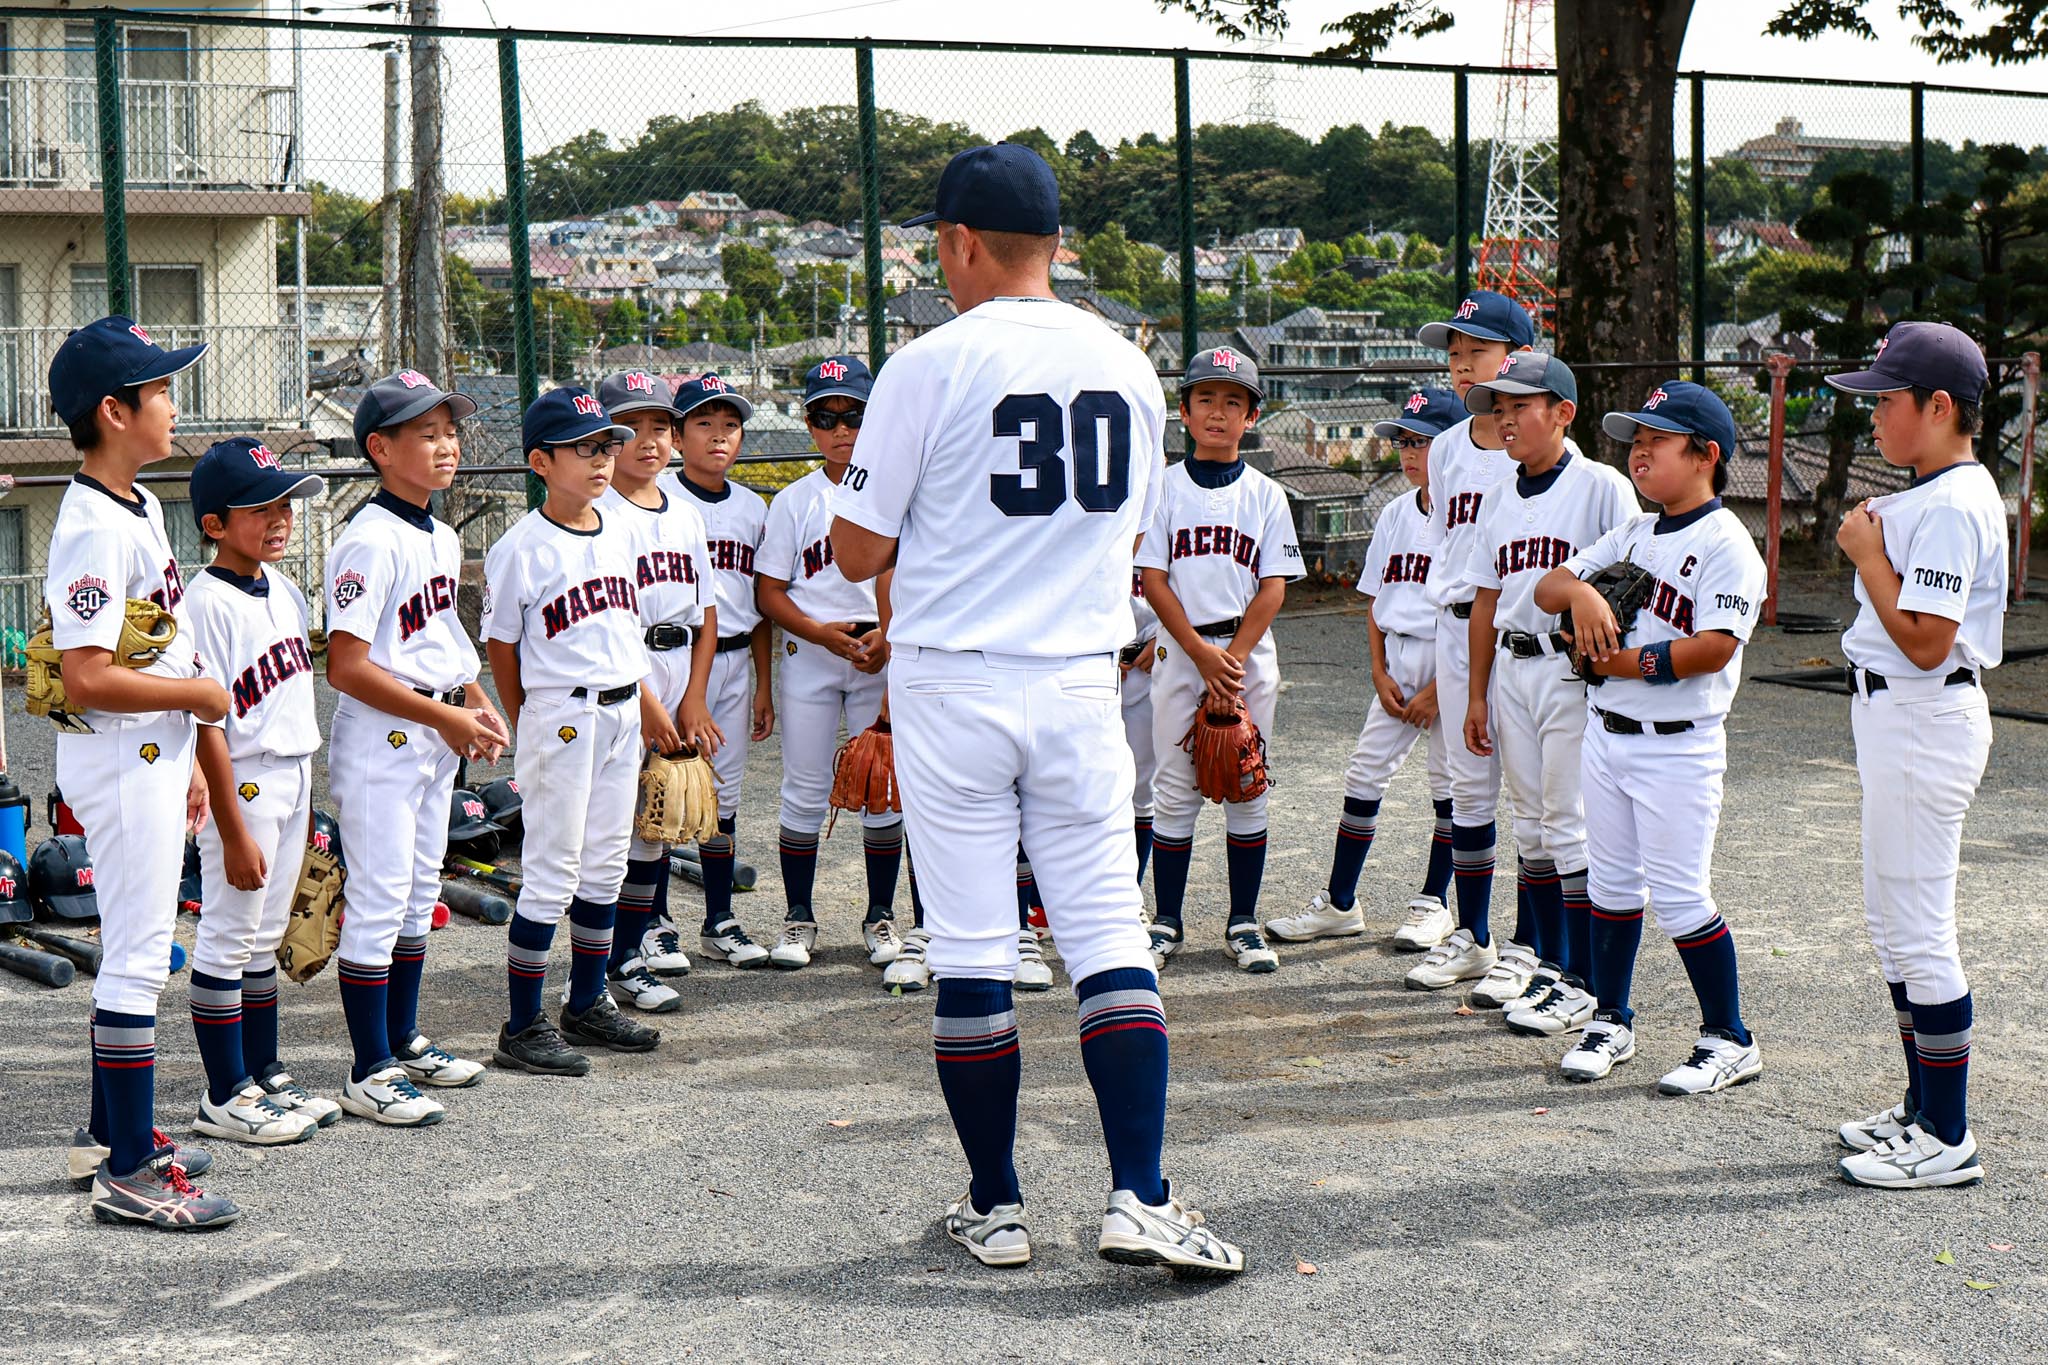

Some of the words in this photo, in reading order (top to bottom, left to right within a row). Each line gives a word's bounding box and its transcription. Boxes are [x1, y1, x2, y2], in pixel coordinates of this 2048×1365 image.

[820, 361, 848, 381] MT
[1213, 350, 1241, 372] MT
[626, 372, 655, 394] MT
[702, 376, 728, 394] MT
[573, 394, 603, 418] MT
[990, 390, 1131, 517] 30
[840, 462, 869, 492] YO
[1680, 554, 1698, 578] C
[1914, 567, 1962, 593] TOKYO
[76, 590, 101, 612] 50
[338, 584, 357, 601] 50
[1640, 651, 1659, 676] MT
[463, 800, 485, 818] MT
[76, 867, 95, 887] M
